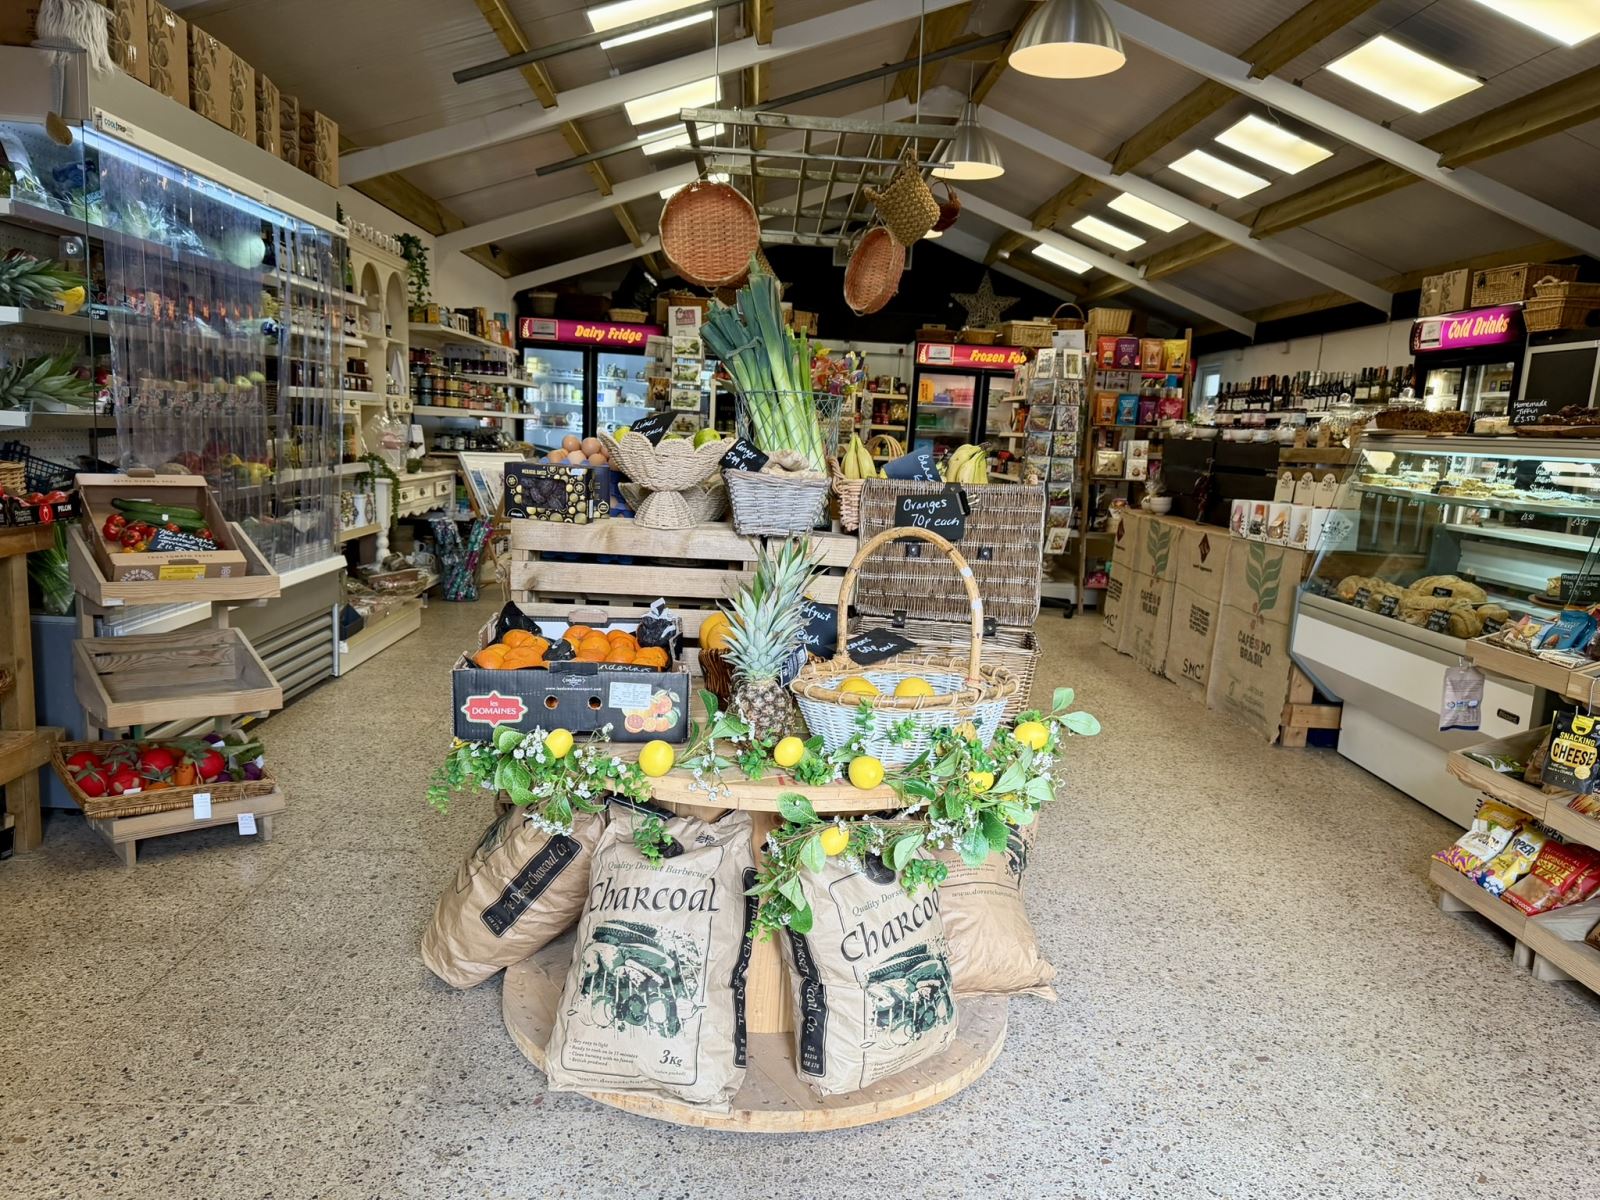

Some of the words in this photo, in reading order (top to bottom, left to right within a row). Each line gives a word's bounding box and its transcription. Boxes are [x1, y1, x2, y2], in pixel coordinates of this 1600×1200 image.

[574, 324, 606, 342] Dairy
[607, 327, 643, 343] Fridge
[1448, 316, 1473, 339] Cold
[1473, 313, 1510, 336] Drinks
[969, 349, 1005, 363] Frozen
[1007, 351, 1027, 364] Foo
[1513, 400, 1548, 409] Homemade
[634, 417, 657, 430] Limes
[1513, 414, 1536, 423] £3.50
[735, 440, 757, 459] Ginger
[903, 499, 947, 514] Oranges
[911, 514, 931, 528] 70p
[934, 517, 960, 526] each
[796, 629, 820, 645] each
[1260, 639, 1271, 656] DO
[1240, 646, 1263, 668] BRASIL
[471, 707, 517, 716] DOMAINES
[1560, 731, 1596, 747] SNACKING
[1552, 742, 1596, 766] CHEESE
[528, 849, 559, 885] Charcoal
[607, 861, 633, 871] Quality
[634, 861, 664, 872] Dorset
[665, 865, 708, 879] Barbecue
[589, 877, 721, 913] Charcoal
[852, 898, 880, 917] Quality
[806, 1016, 818, 1034] Co.
